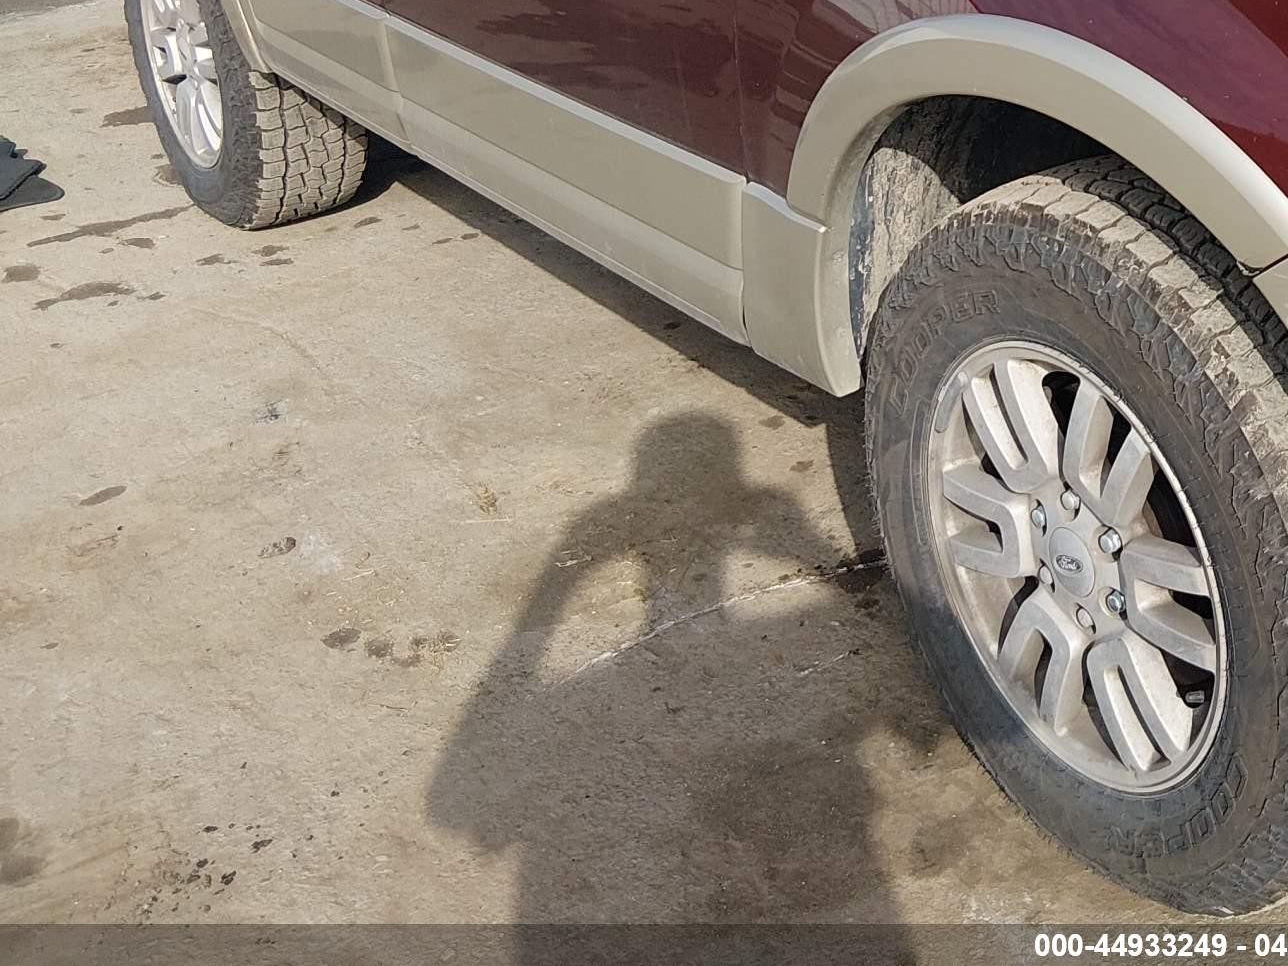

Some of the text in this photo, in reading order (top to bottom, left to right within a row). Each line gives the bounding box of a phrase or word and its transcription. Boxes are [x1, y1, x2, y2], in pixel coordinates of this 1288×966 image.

[888, 289, 1001, 419] COOPER
[1058, 555, 1079, 571] Ford
[1106, 751, 1249, 859] COOPER
